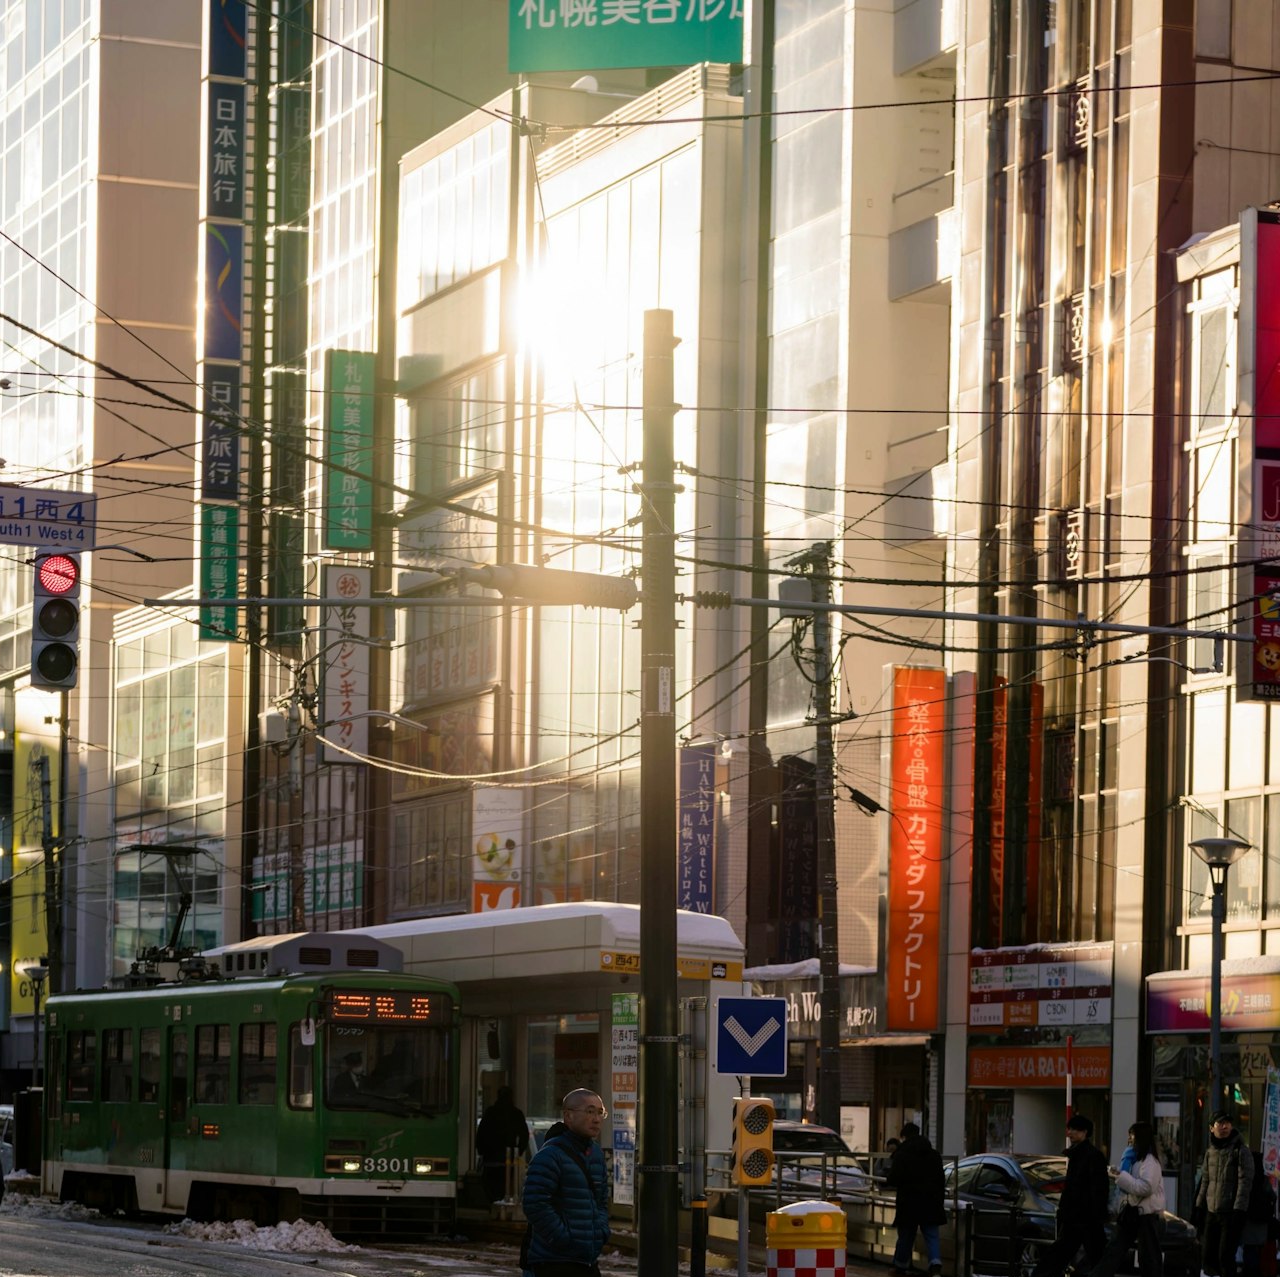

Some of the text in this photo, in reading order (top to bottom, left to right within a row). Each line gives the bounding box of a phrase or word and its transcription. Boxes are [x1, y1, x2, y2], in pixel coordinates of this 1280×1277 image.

[213, 98, 238, 203] 日本旅行
[208, 380, 233, 486] 日本旅行
[341, 361, 363, 541] 札幌美容形成外科
[38, 525, 73, 540] West
[76, 528, 85, 541] 4
[697, 833, 710, 895] Watch
[1243, 993, 1272, 1008] 三越前店
[336, 1026, 365, 1036] ワンマン
[363, 1157, 410, 1174] 3301
